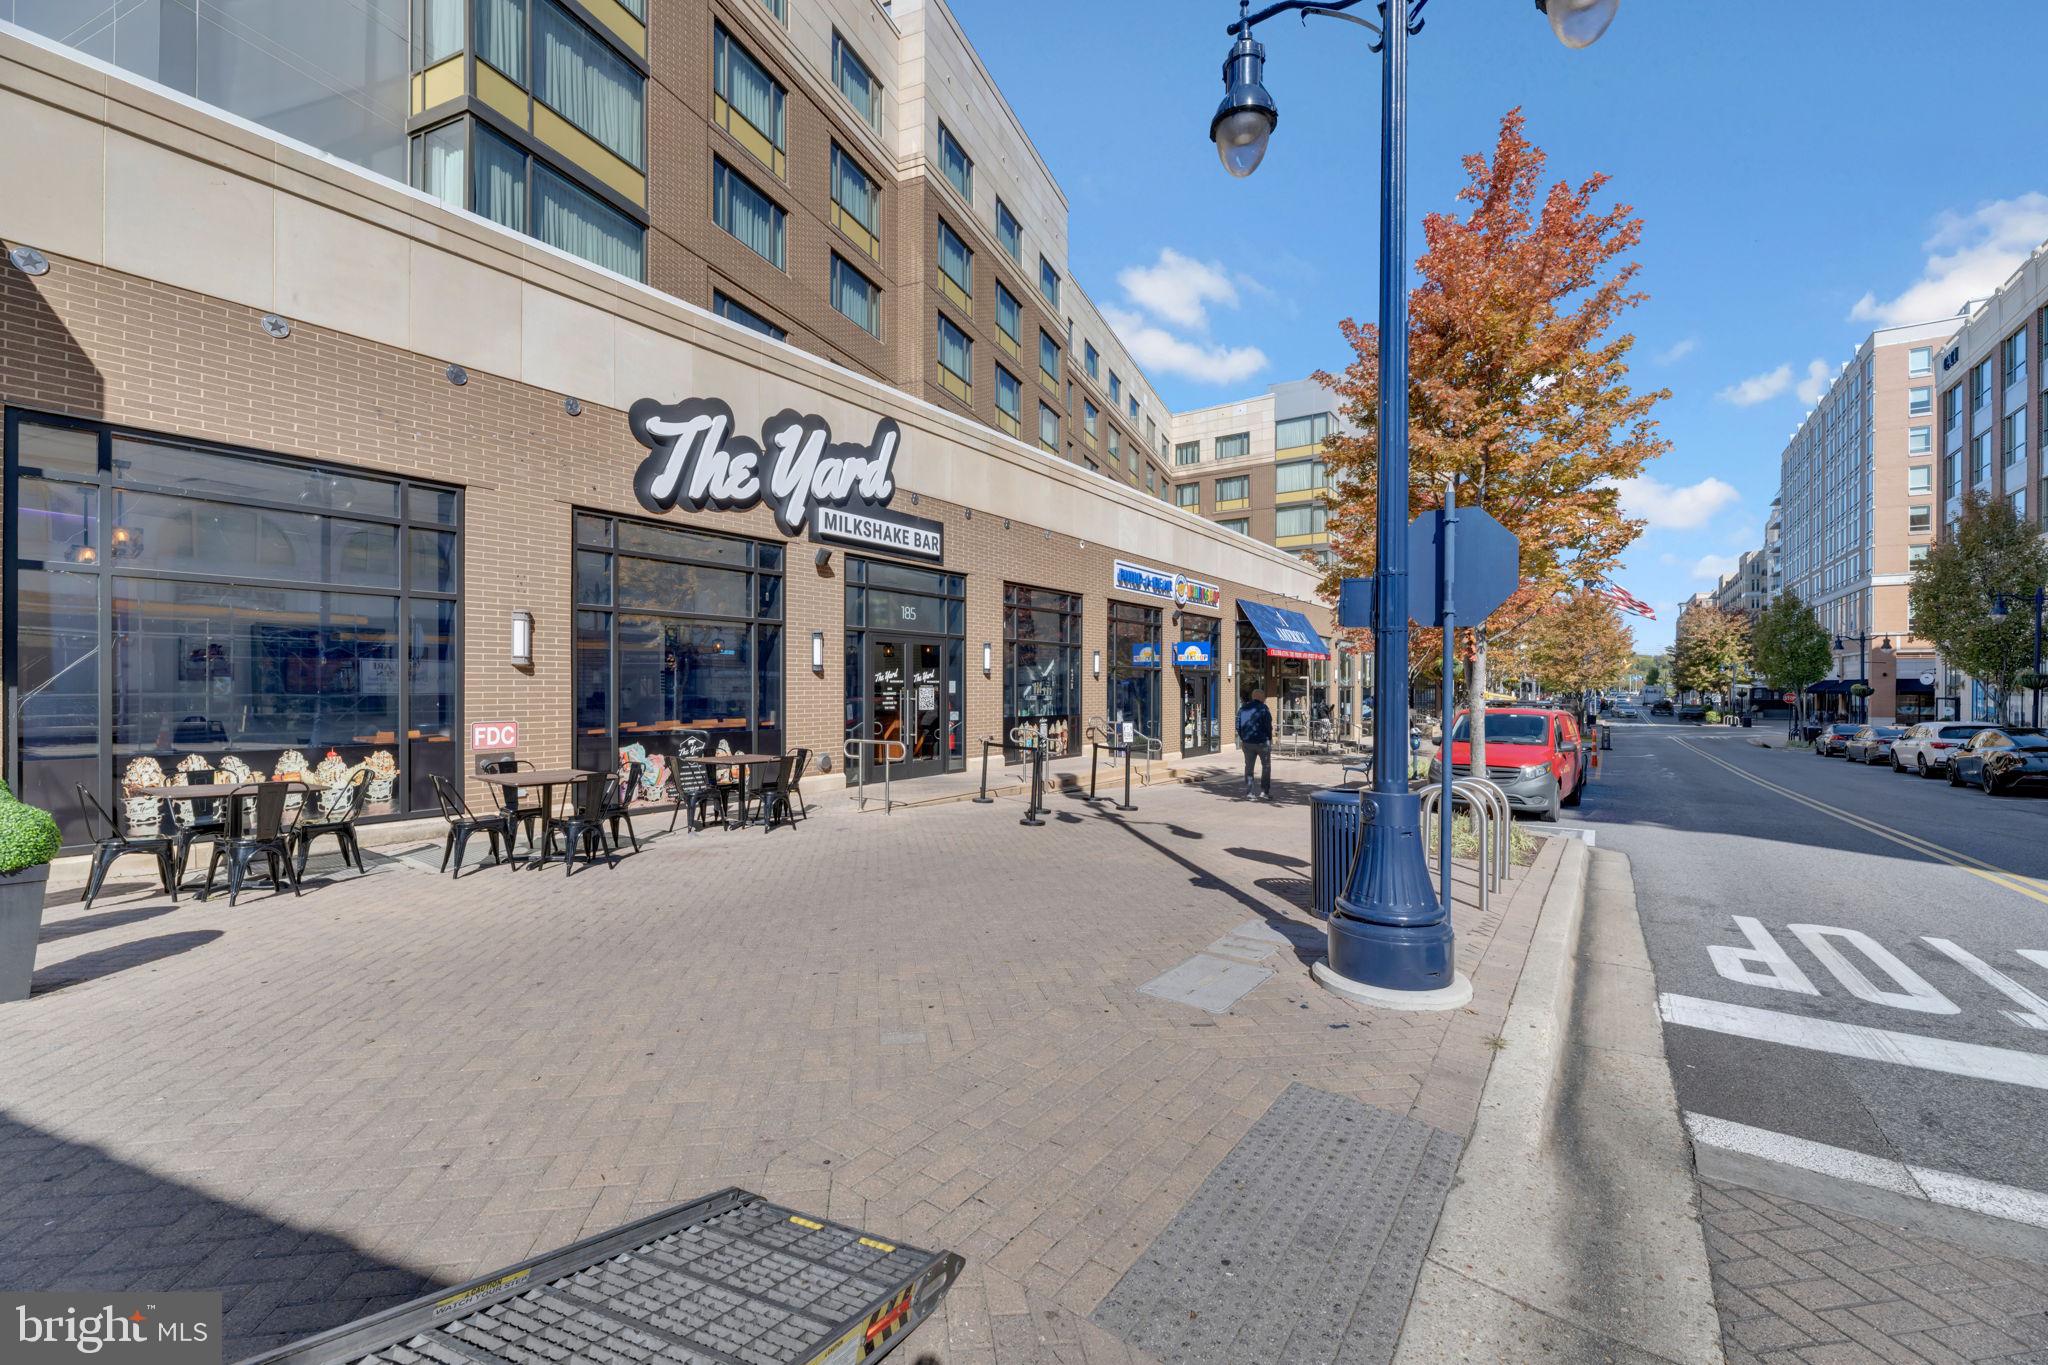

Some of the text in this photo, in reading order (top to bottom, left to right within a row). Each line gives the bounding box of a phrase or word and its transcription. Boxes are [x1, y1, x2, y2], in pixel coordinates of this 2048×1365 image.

[646, 415, 897, 527] The Yard
[824, 511, 939, 552] MILKSHAKE BAR
[900, 605, 917, 621] 185
[474, 725, 516, 747] FDC
[1706, 915, 2048, 1031] TOP
[436, 1275, 529, 1315] WATCH YOUR STEP
[470, 1278, 504, 1296] CAUTION
